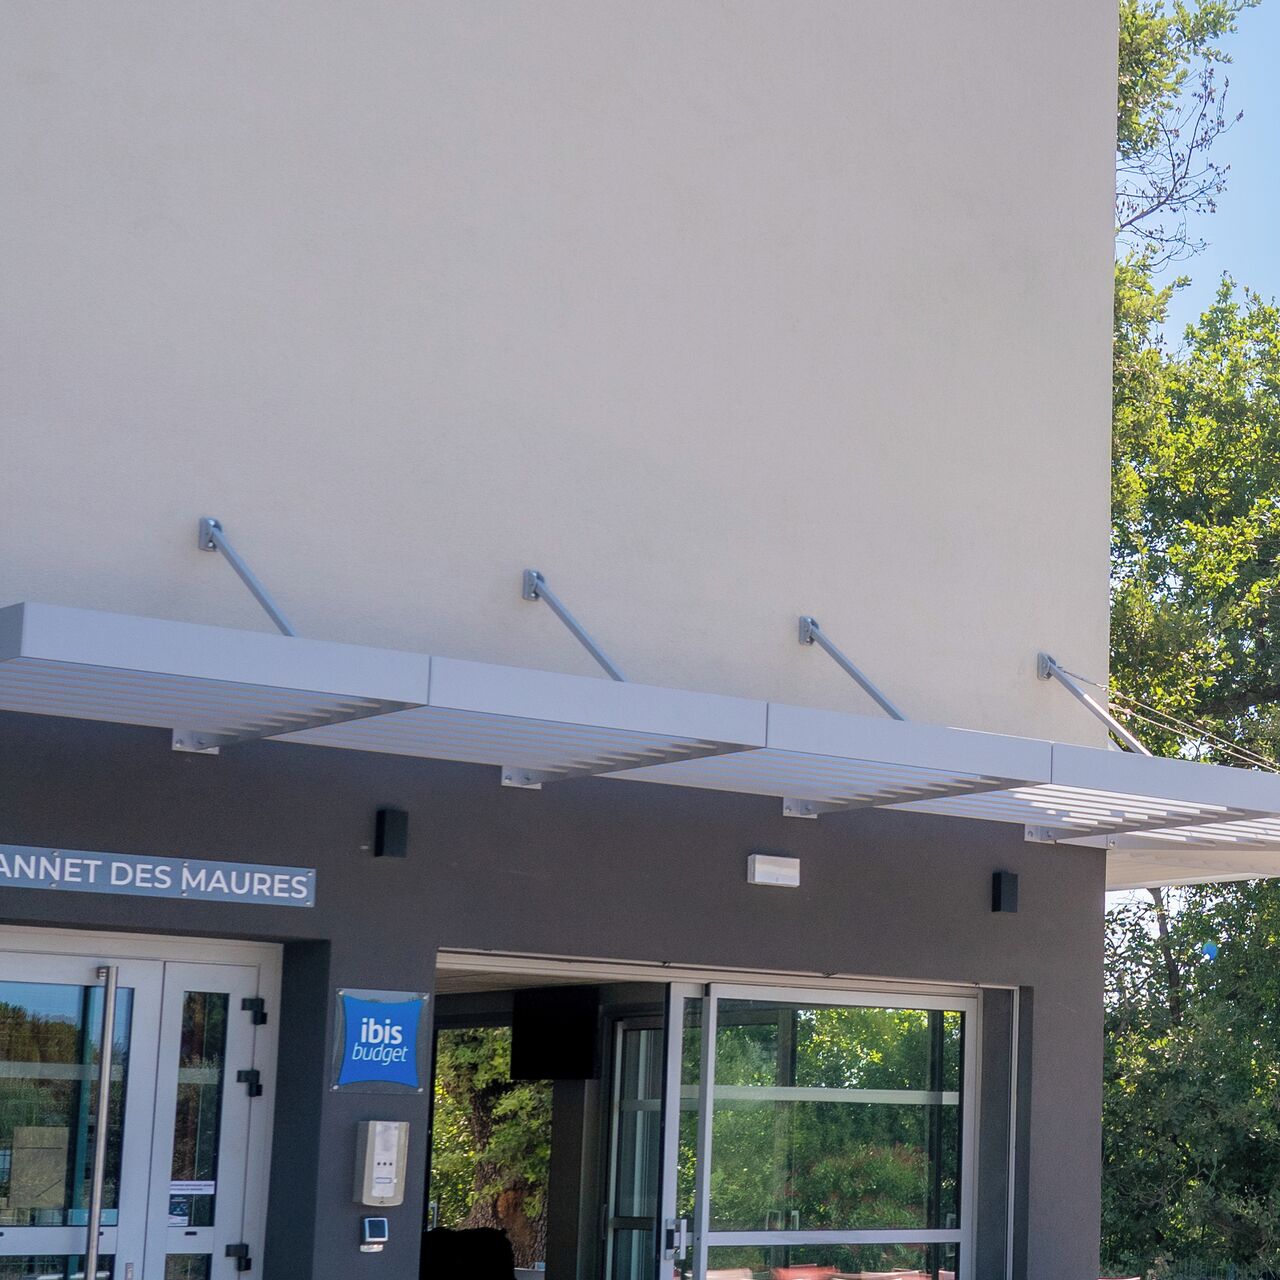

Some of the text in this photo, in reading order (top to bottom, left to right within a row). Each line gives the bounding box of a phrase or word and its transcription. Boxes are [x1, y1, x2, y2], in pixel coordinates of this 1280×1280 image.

[110, 861, 172, 889] DES
[181, 867, 308, 899] MAURES
[361, 1017, 403, 1045] ibis
[352, 1042, 409, 1066] budget
